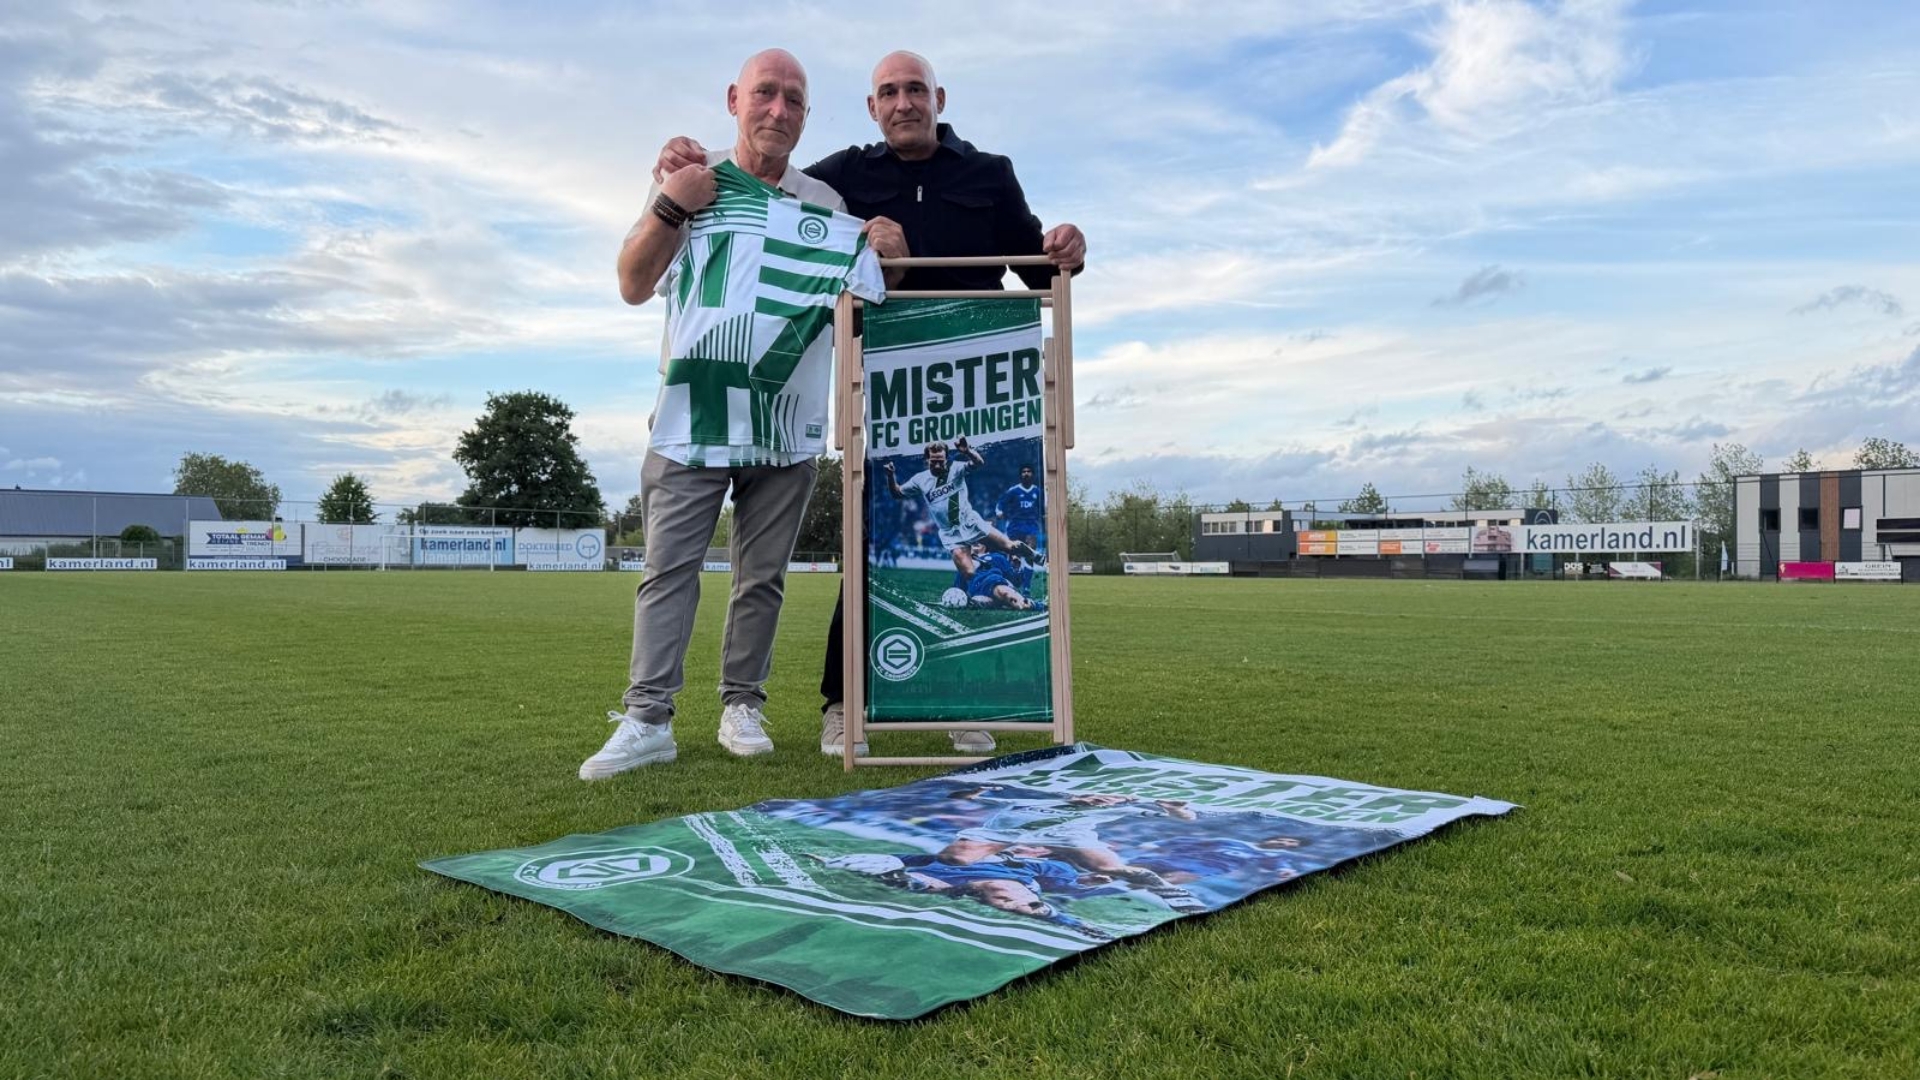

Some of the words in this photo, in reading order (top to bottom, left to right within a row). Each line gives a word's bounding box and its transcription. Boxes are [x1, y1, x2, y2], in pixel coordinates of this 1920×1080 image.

[870, 347, 1041, 421] MISTER
[871, 421, 900, 449] FC
[908, 398, 1042, 446] GRONINGEN
[420, 538, 506, 550] kamerlandnl
[1527, 525, 1686, 550] kamerland.nl
[49, 558, 155, 568] kamerland.nl
[189, 560, 285, 569] kamerland.nl
[1029, 755, 1469, 813] MISTER
